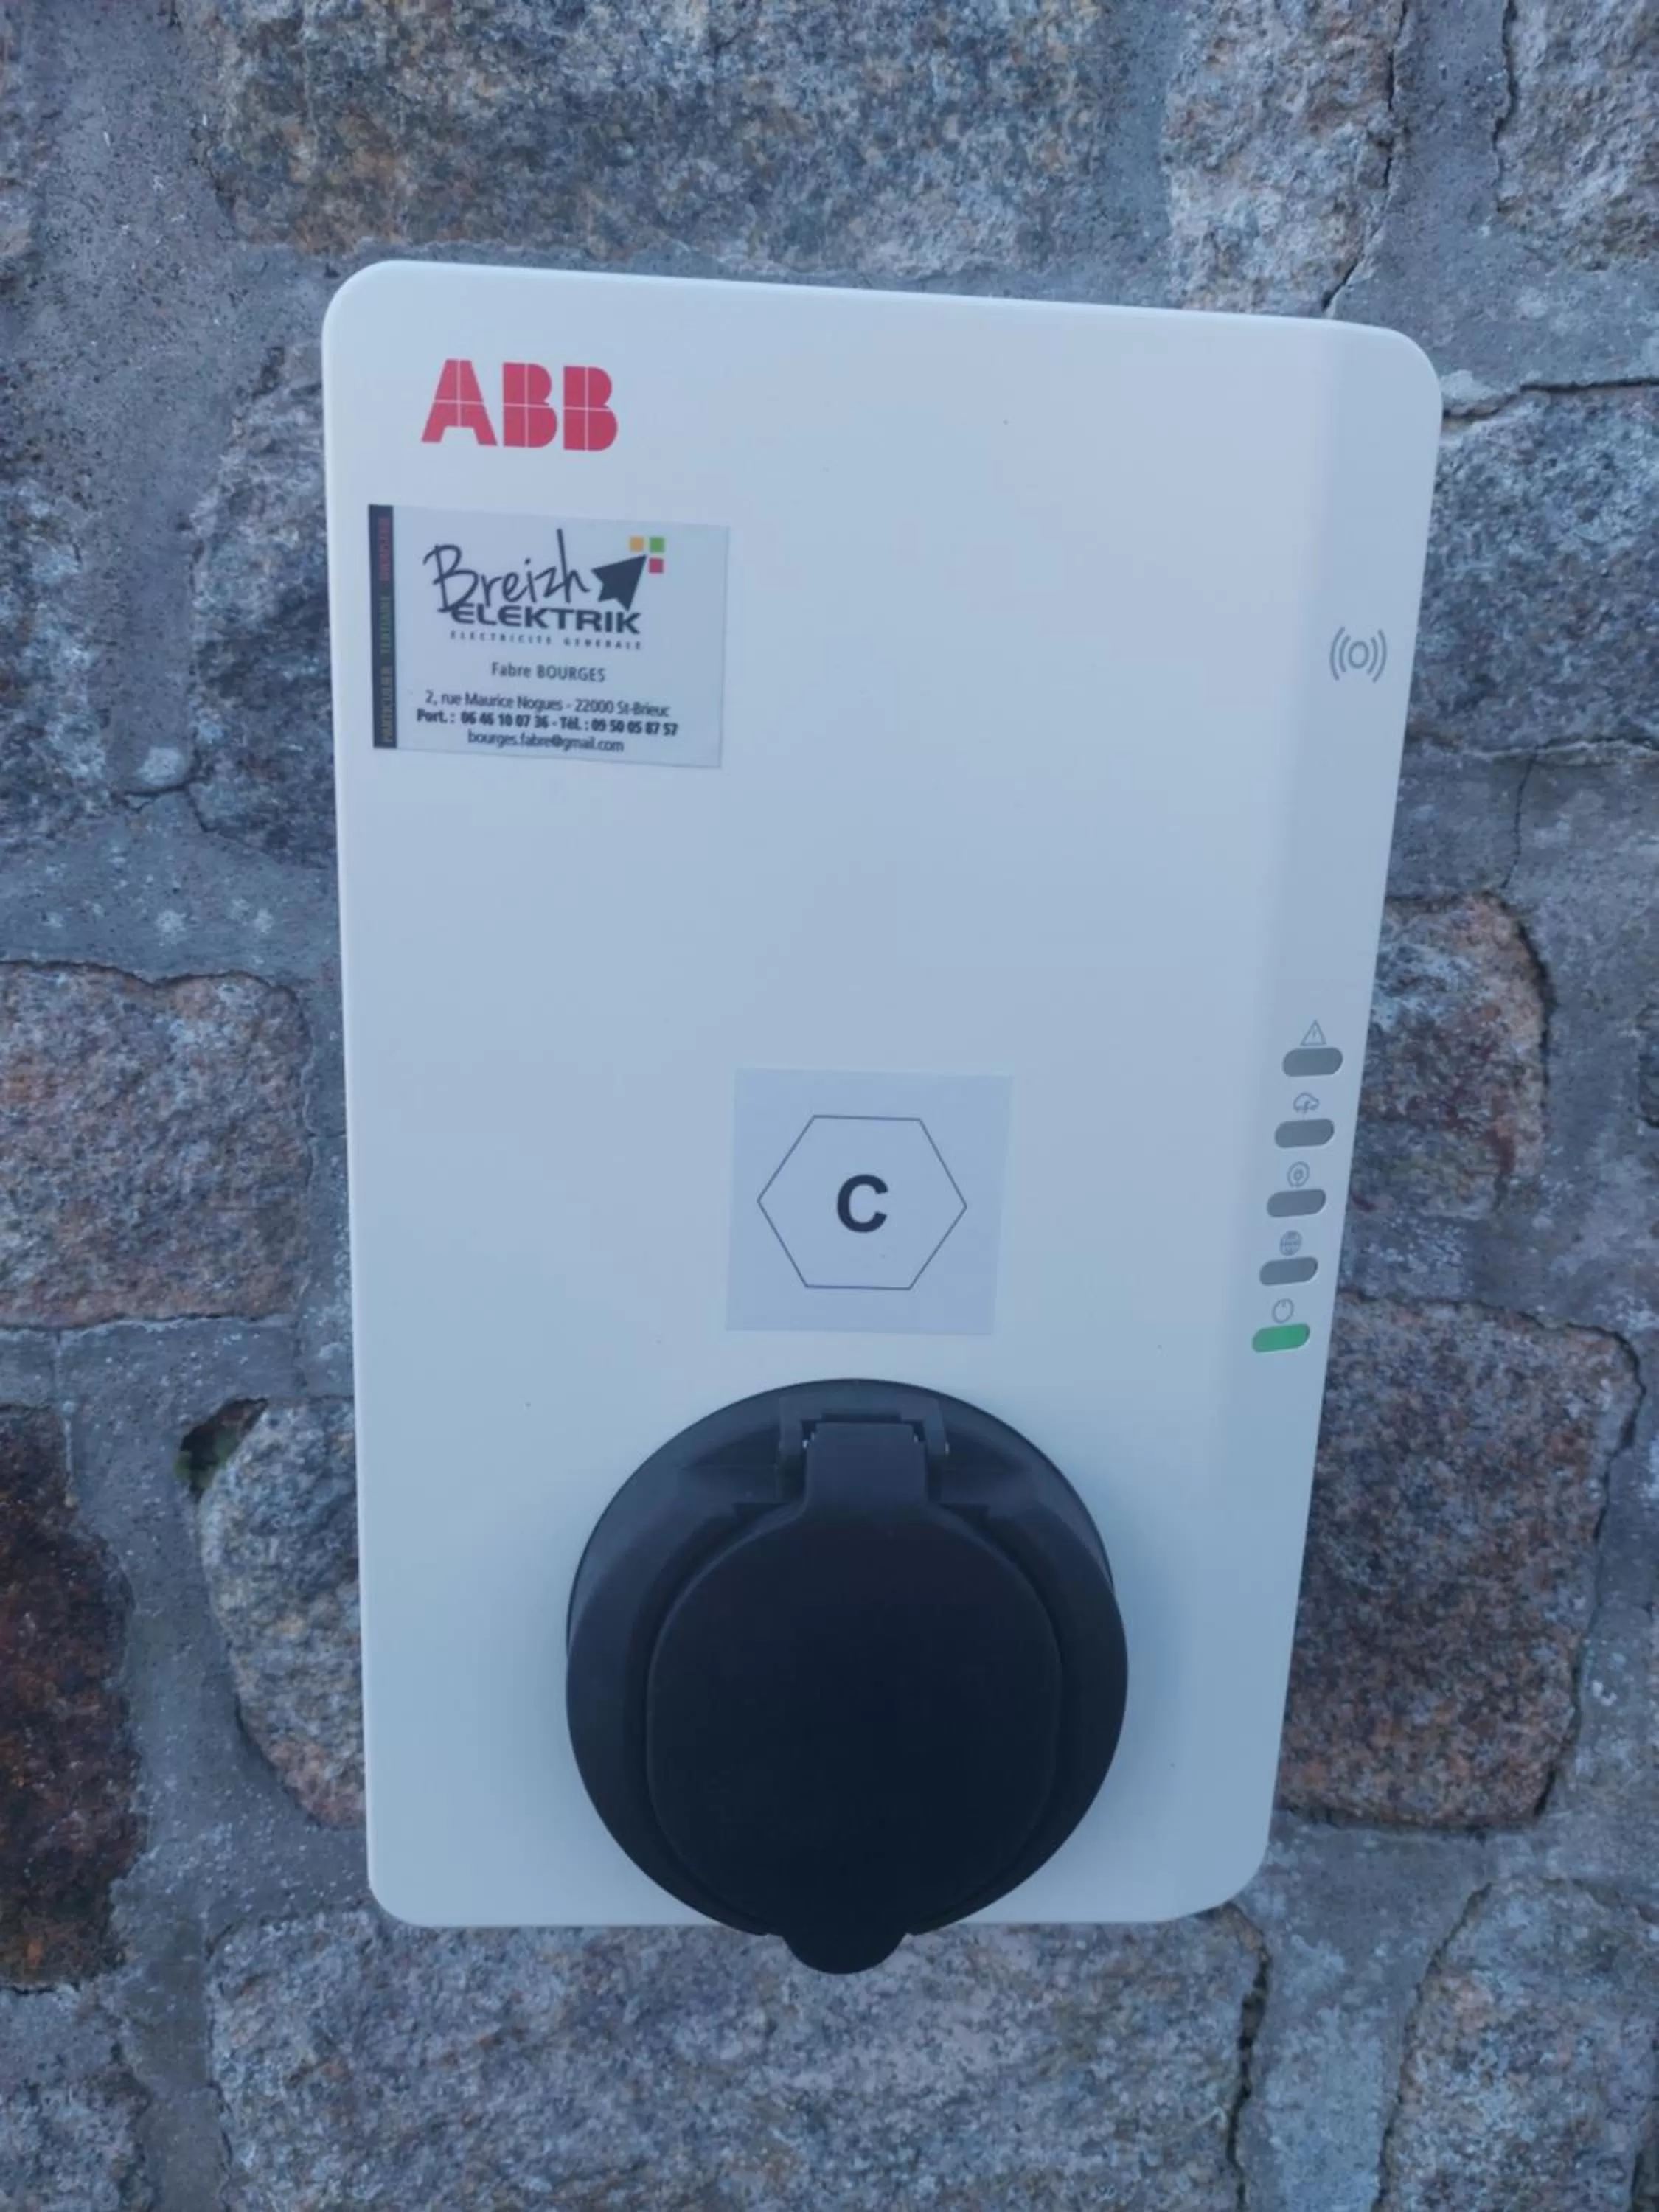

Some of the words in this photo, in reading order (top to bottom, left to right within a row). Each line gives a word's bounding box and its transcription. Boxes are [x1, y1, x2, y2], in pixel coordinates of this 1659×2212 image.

[421, 358, 619, 451] ABB
[422, 528, 590, 613] Breizh
[451, 603, 641, 635] ELEKTRIK
[491, 661, 532, 678] Fabre
[536, 664, 606, 683] BOURGES
[425, 689, 437, 706] 2,
[441, 693, 462, 706] rue
[465, 691, 514, 709] Maurice
[574, 698, 614, 714] 22000
[498, 713, 513, 727] 10
[836, 1173, 888, 1234] C
